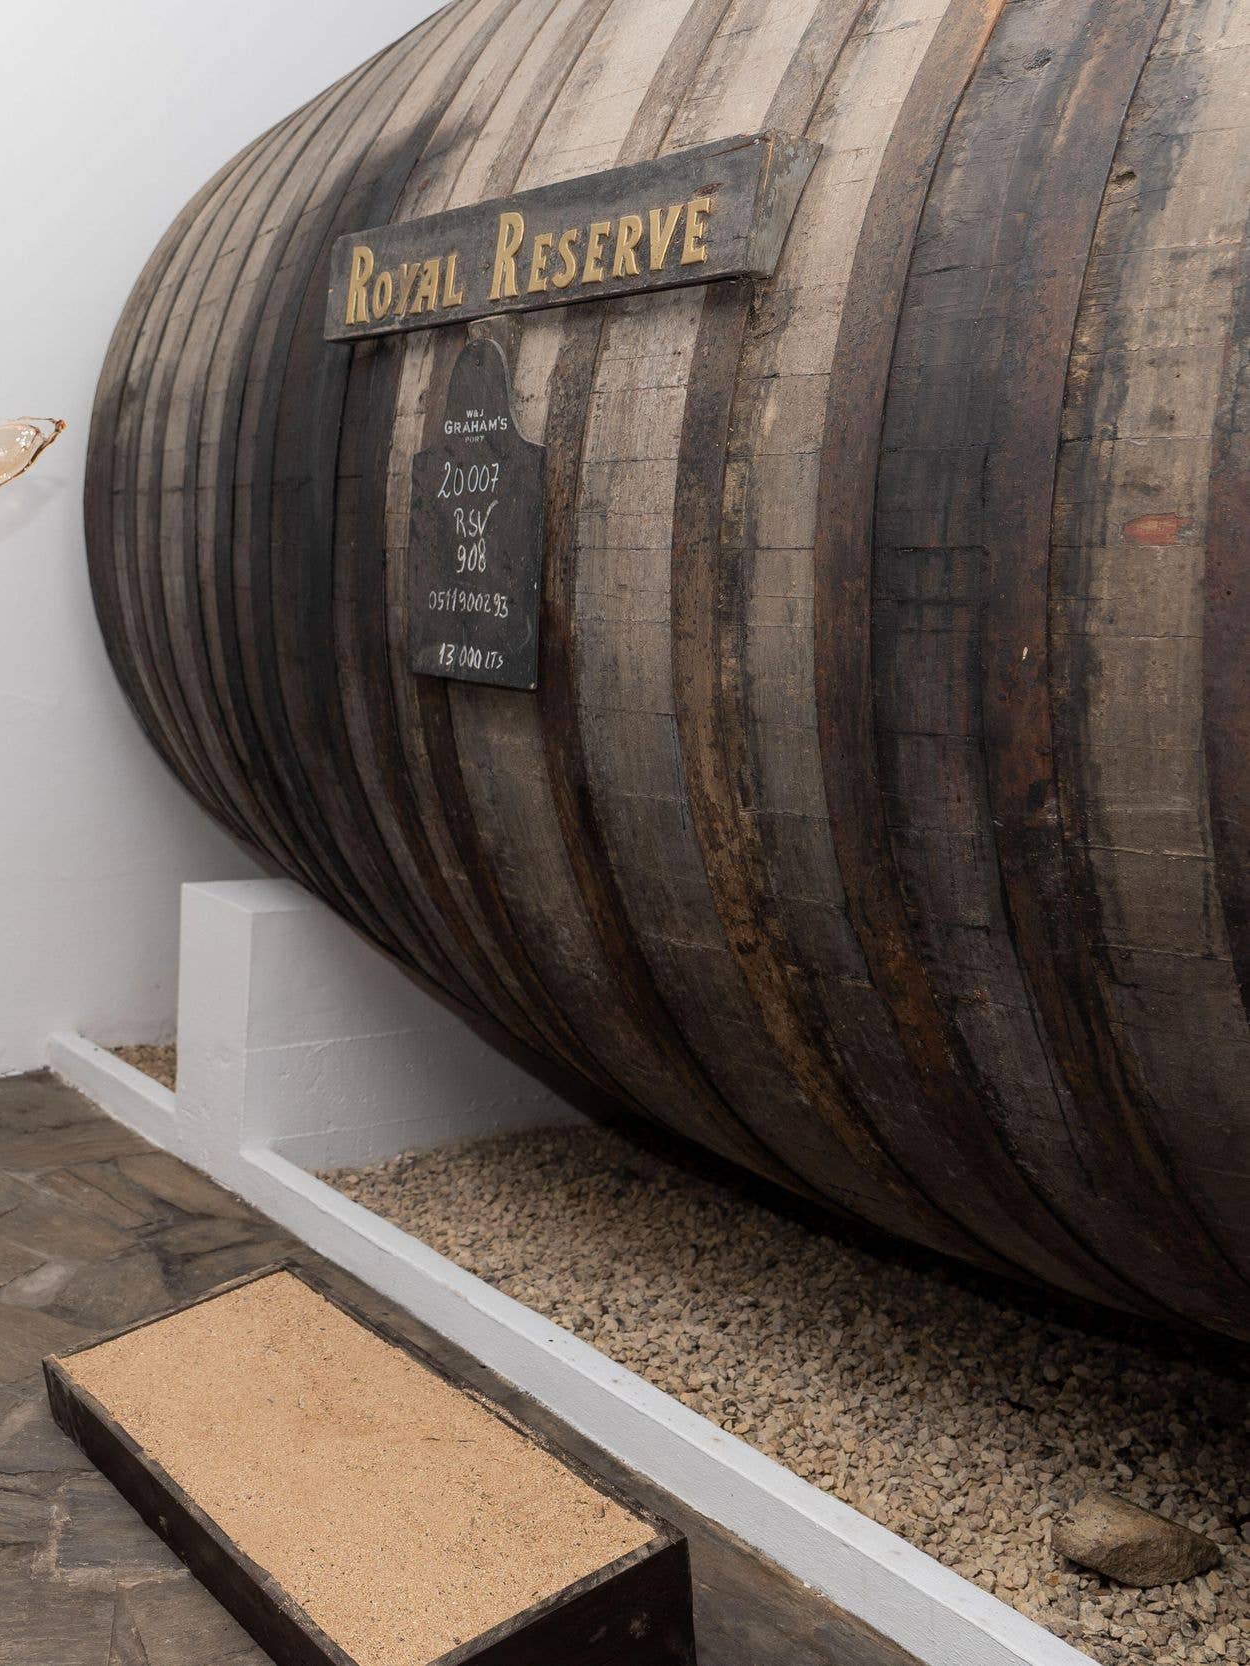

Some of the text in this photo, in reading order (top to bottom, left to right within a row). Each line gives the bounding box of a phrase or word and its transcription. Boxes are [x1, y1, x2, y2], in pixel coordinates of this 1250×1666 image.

[488, 198, 711, 300] RESERVE
[444, 416, 508, 435] GRAHAM'S
[465, 435, 485, 443] PORT
[453, 500, 499, 537] RSV
[456, 538, 487, 573] 908
